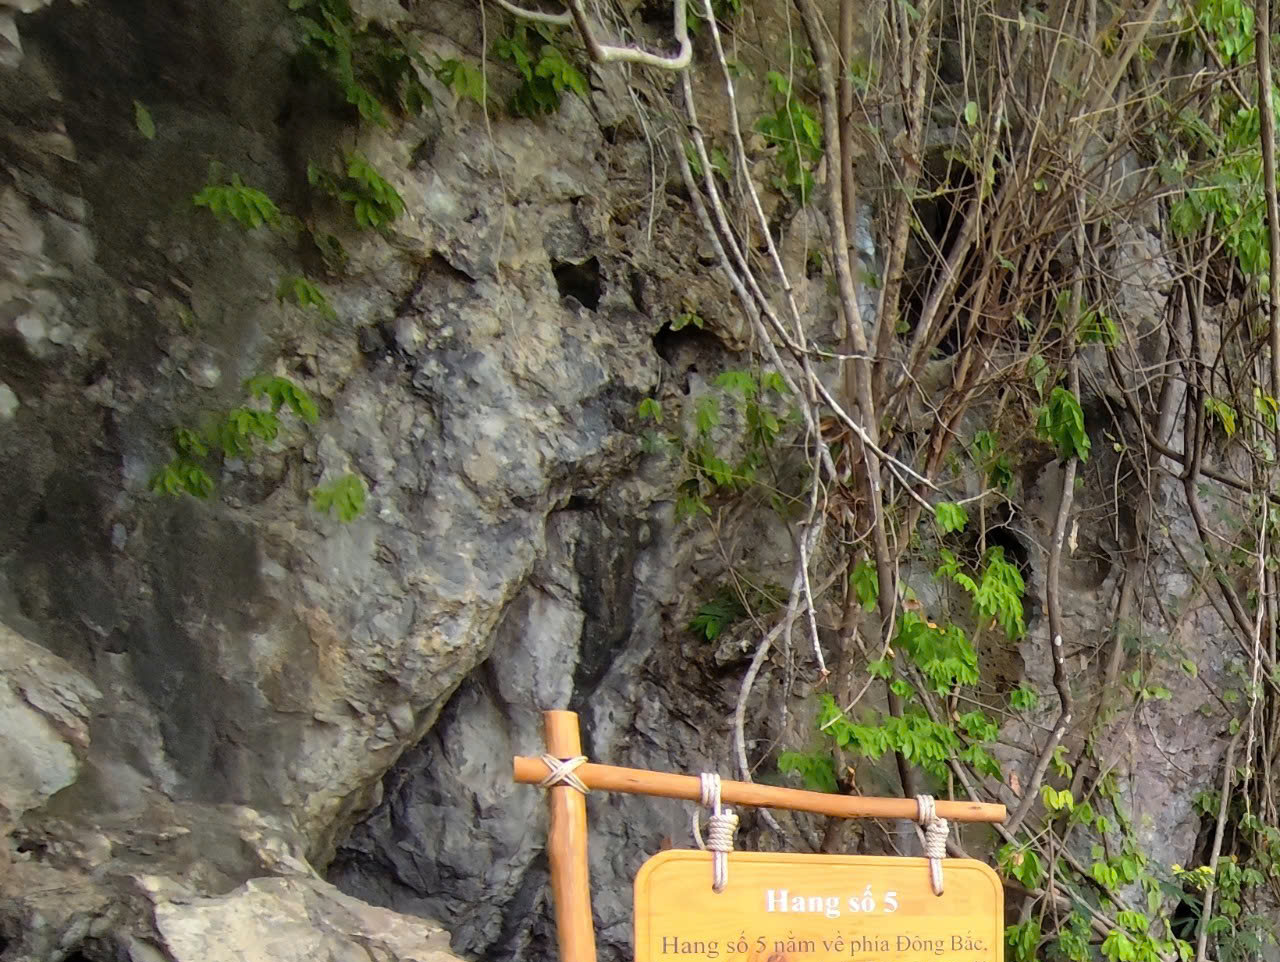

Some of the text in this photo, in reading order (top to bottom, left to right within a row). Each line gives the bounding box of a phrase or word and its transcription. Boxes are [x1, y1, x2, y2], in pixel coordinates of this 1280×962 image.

[767, 884, 898, 919] Hang số 5
[662, 936, 719, 958] Hang
[726, 930, 749, 953] số
[755, 936, 767, 953] 5
[774, 930, 815, 953] nằm
[823, 930, 845, 952] về
[851, 935, 890, 957] phía
[896, 935, 945, 955] Đông
